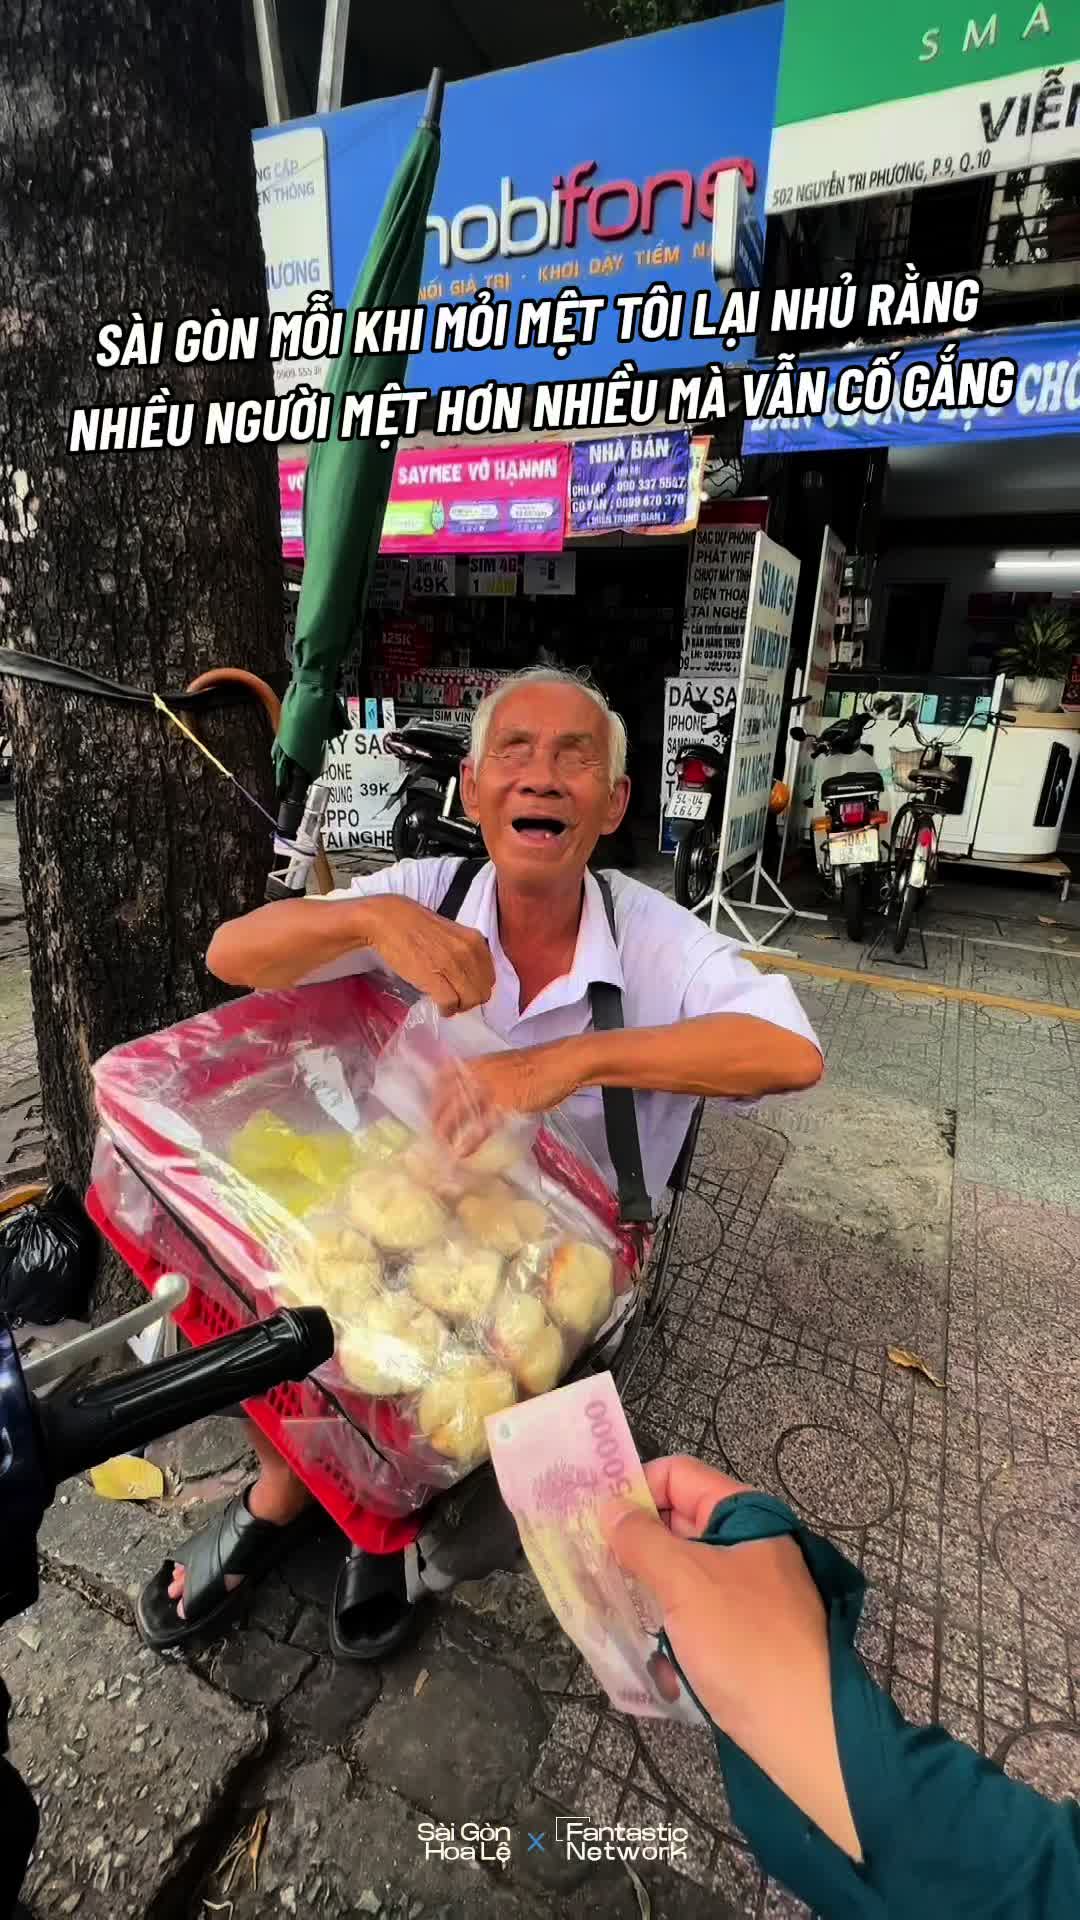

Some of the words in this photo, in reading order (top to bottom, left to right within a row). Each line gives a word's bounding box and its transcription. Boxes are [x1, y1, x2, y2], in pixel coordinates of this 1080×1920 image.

[796, 169, 846, 201] NGUYỄN
[589, 438, 626, 465] NHÀ
[398, 463, 463, 486] SAYMEE
[469, 457, 491, 481] VÔ
[669, 681, 709, 707] DÂY
[434, 709, 452, 723] SIM
[360, 783, 391, 797] 39K
